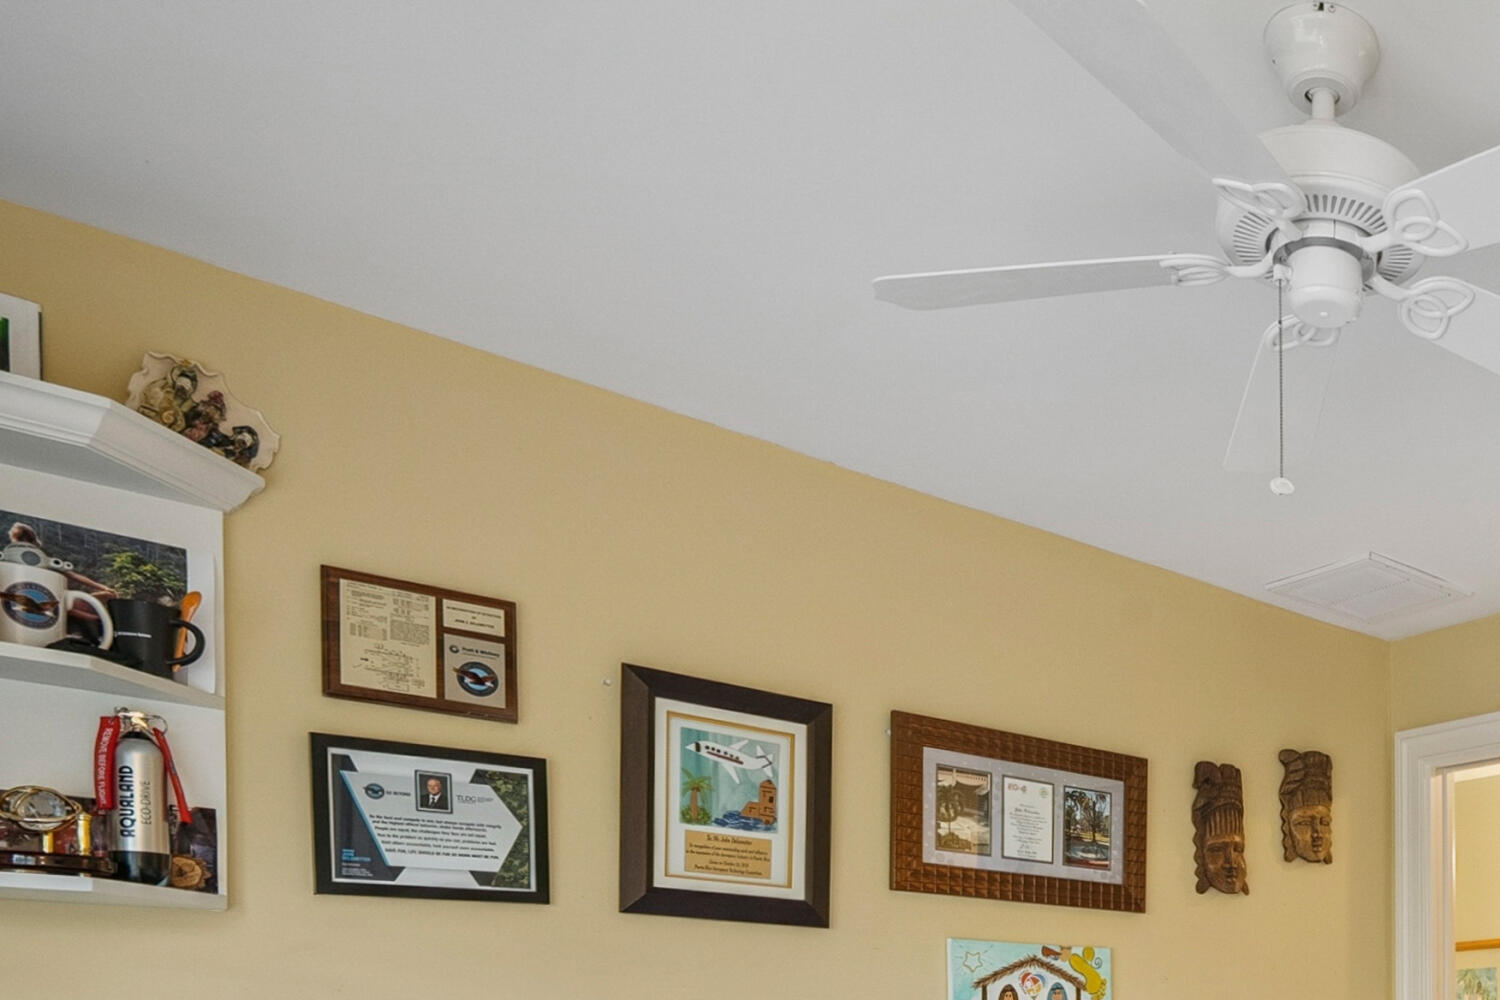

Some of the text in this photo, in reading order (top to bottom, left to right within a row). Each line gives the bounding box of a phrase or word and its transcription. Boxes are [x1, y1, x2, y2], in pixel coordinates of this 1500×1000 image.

[98, 727, 113, 753] REMOVE
[98, 754, 107, 780] BEFORE
[119, 765, 135, 838] AQUALAND
